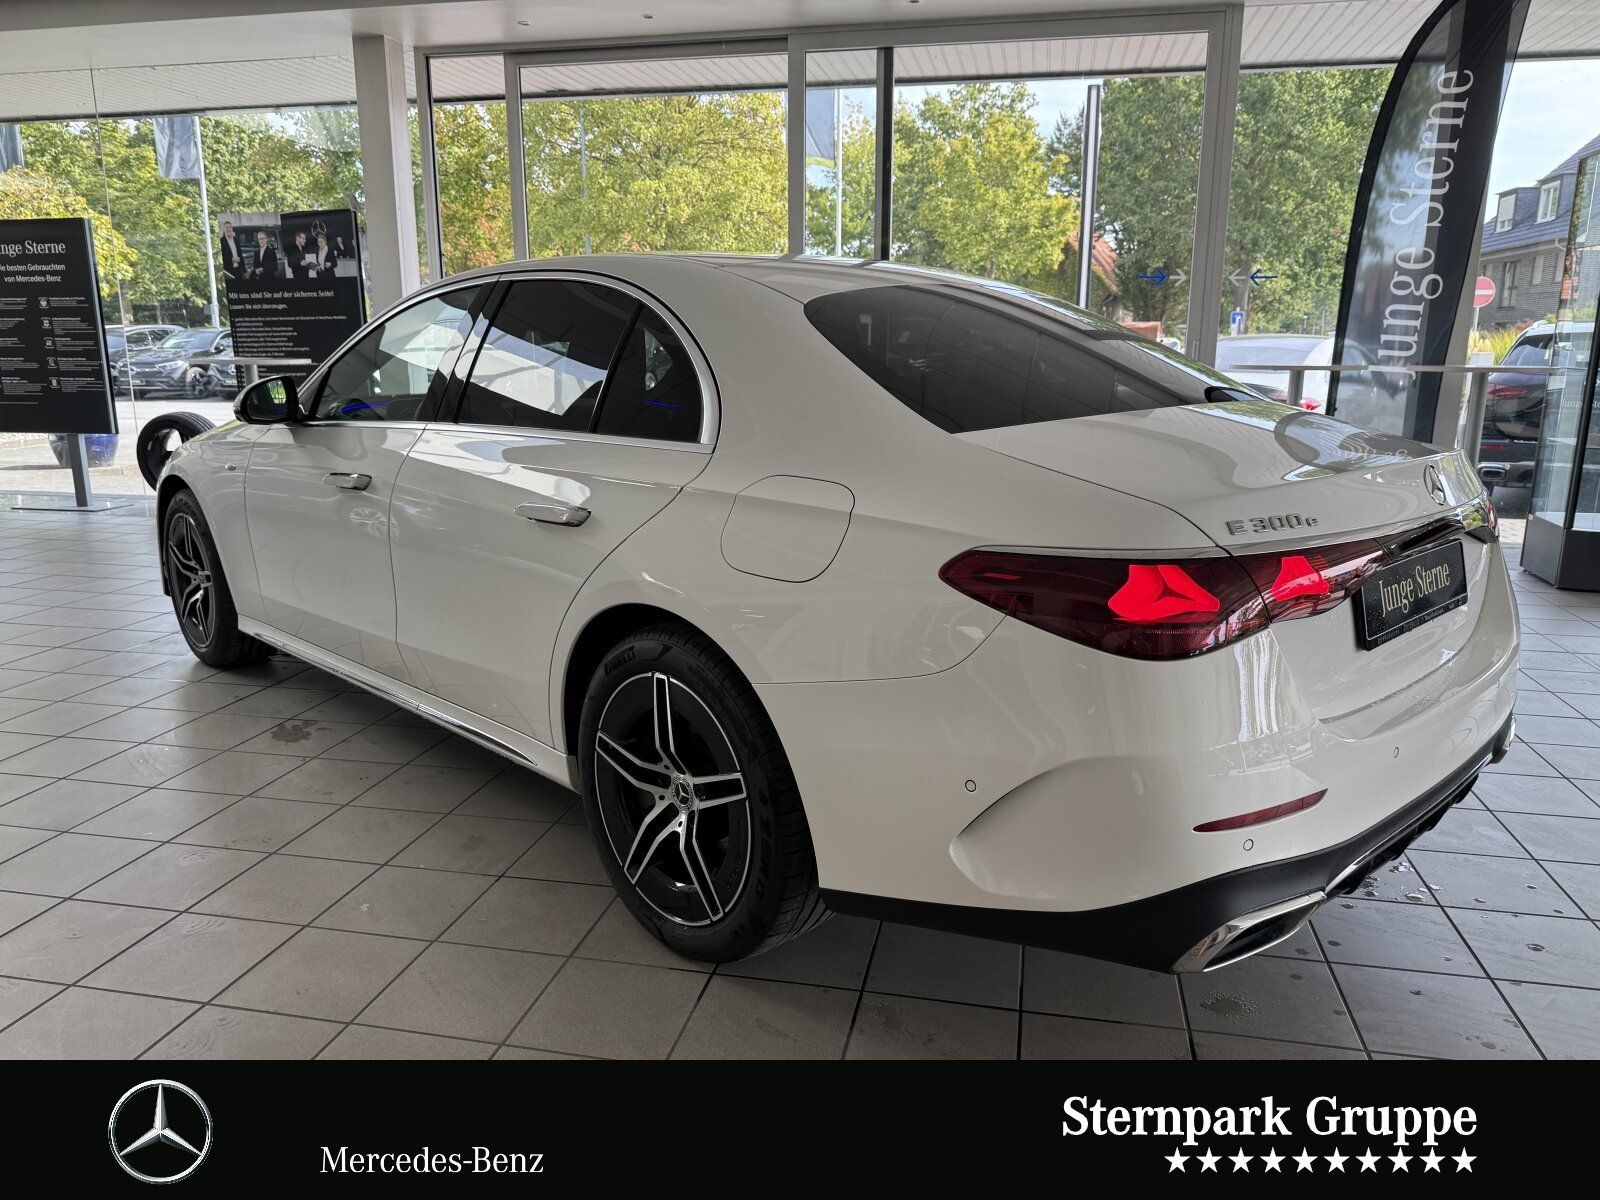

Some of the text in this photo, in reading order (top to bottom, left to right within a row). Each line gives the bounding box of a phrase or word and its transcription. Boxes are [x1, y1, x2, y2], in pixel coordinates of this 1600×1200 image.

[1368, 69, 1474, 380] Junge Sterne
[0, 240, 66, 257] nge Sterne
[27, 263, 66, 271] Gebrauchten
[15, 274, 62, 282] Mercedes-Benz
[250, 291, 262, 299] sind
[293, 290, 317, 298] sicheren
[1225, 519, 1248, 535] E
[1379, 563, 1451, 618] Junge Sterne
